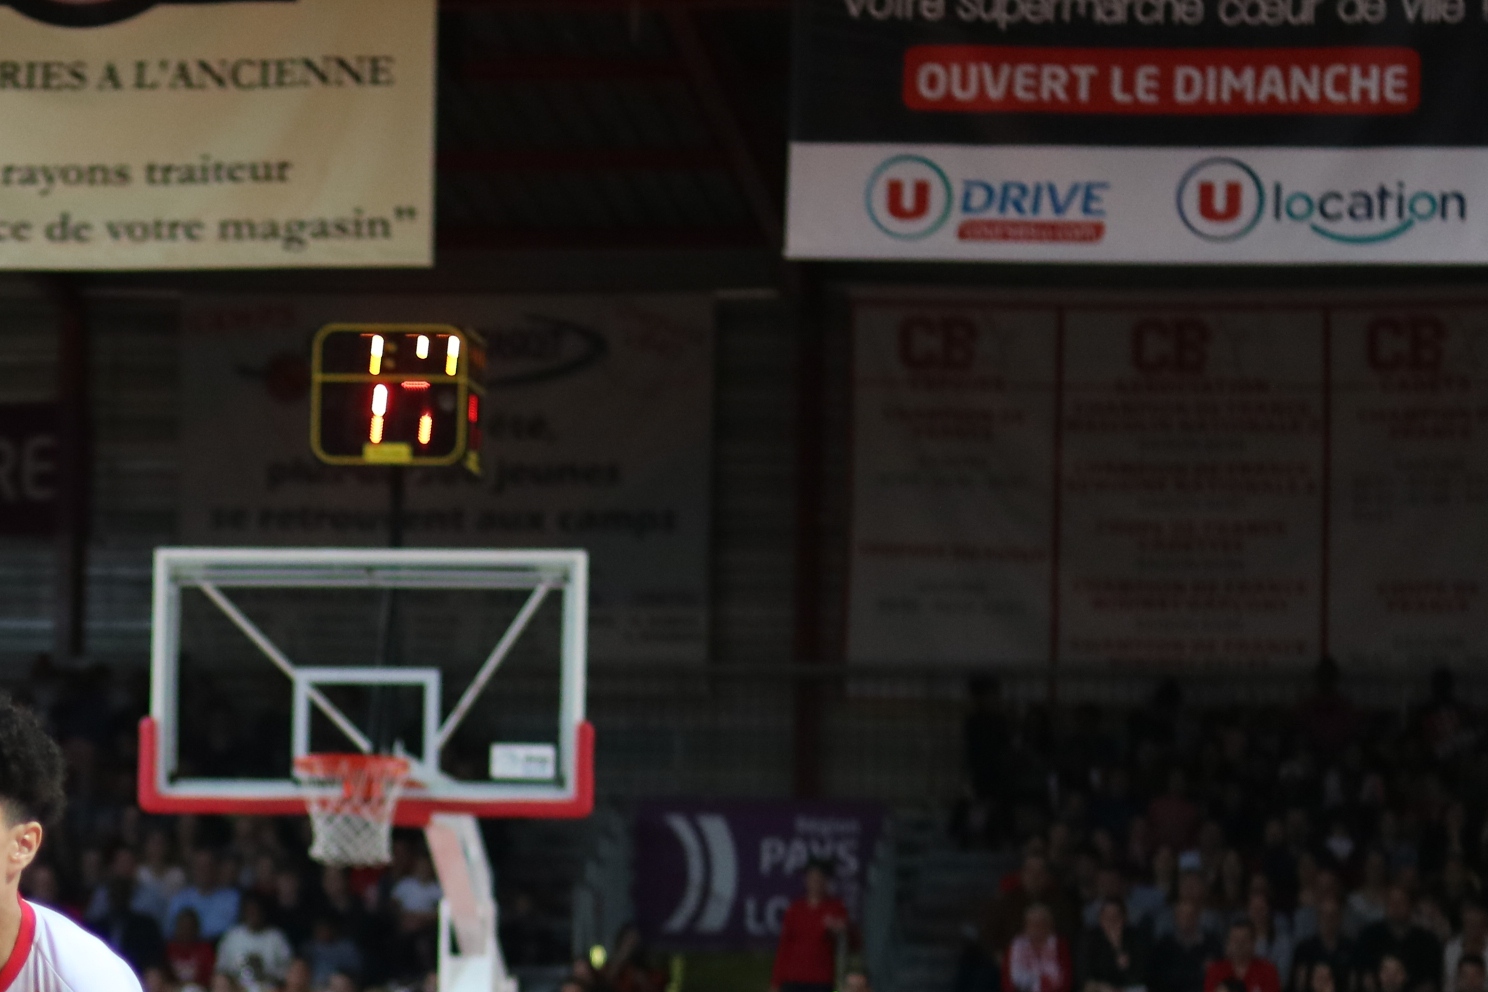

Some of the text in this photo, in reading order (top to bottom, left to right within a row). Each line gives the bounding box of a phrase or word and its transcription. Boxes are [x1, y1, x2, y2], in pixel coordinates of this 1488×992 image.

[99, 59, 125, 91] A
[135, 54, 396, 92] L'ANCIENNE
[916, 62, 1408, 105] OUVERT LE DIMANCHE
[1, 163, 132, 197] rayons
[146, 153, 293, 186] traiteur
[887, 178, 1112, 222] U DRIVE
[1197, 180, 1468, 224] U location
[44, 210, 94, 243] de
[106, 219, 205, 243] votre
